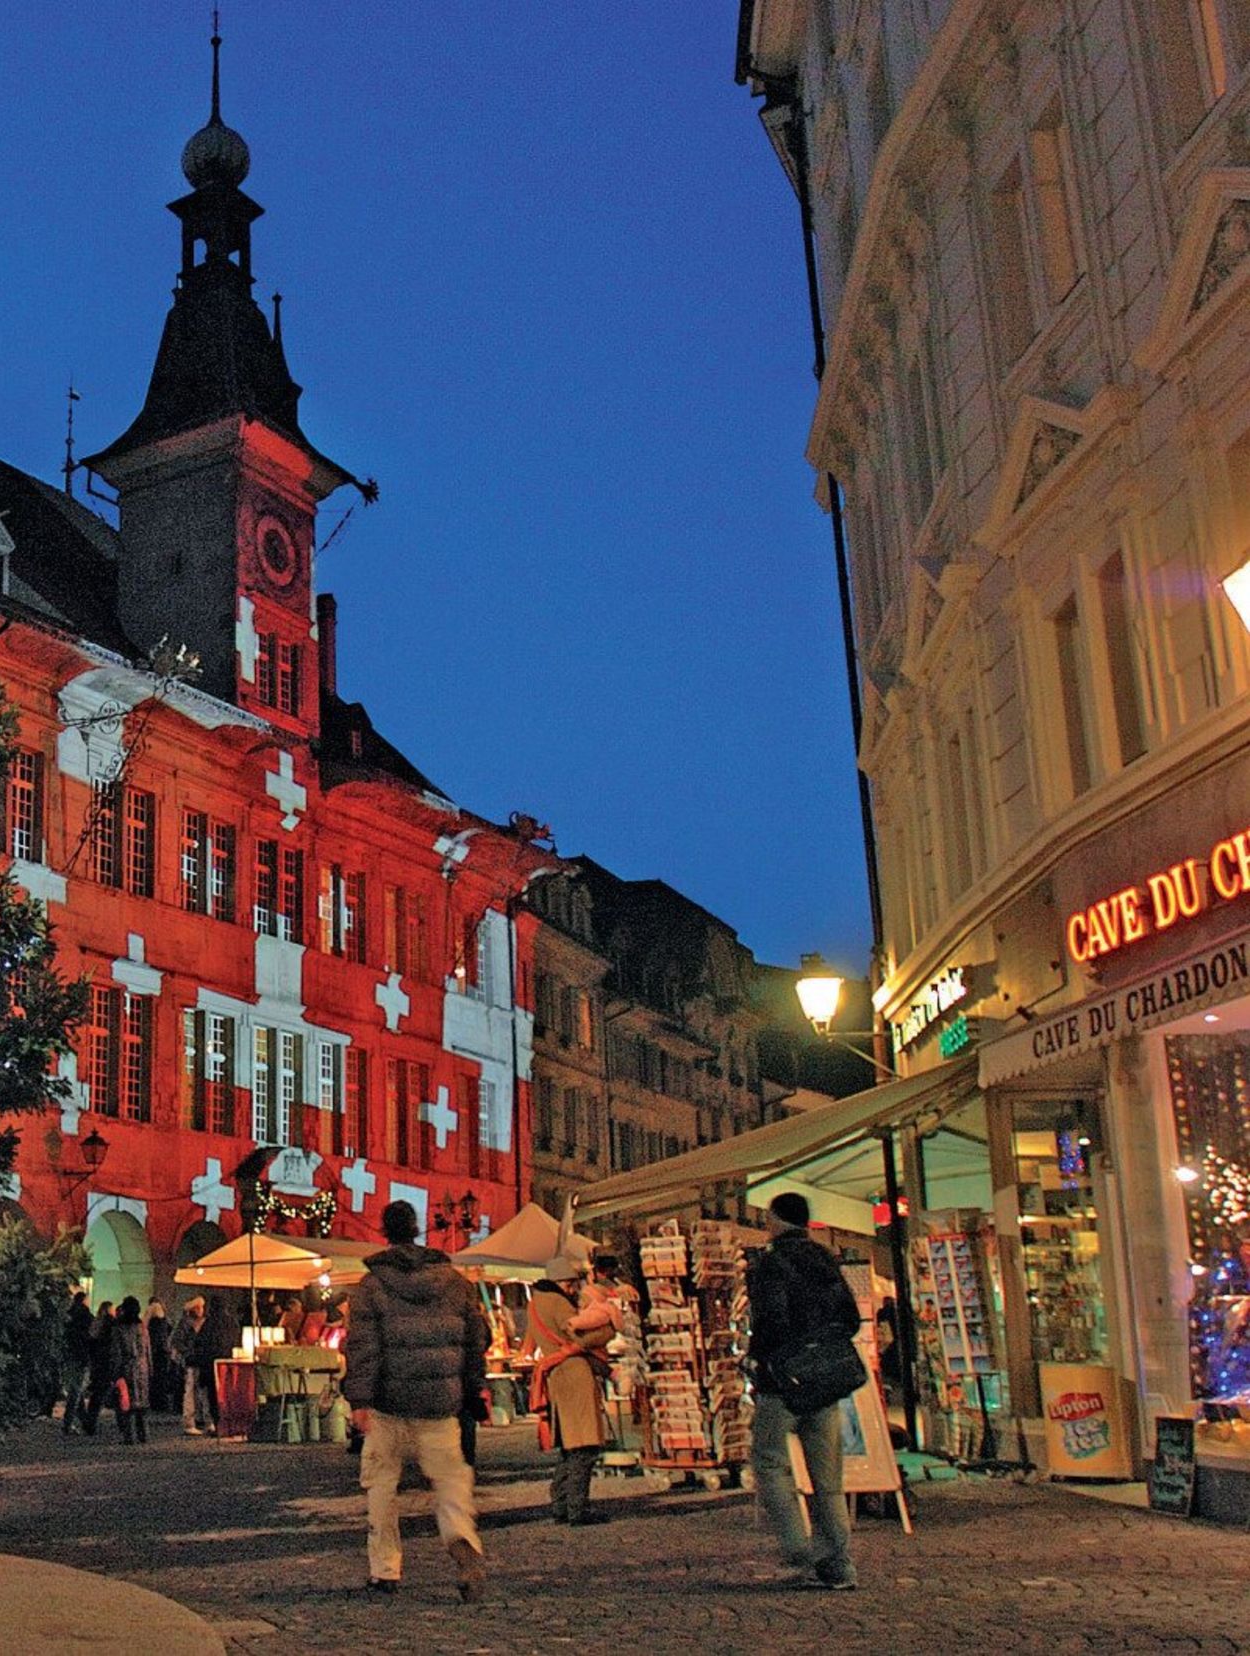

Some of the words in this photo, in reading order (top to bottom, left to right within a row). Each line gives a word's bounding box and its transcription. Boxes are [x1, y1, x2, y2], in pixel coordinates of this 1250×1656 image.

[1067, 888, 1144, 962] CAVE
[1148, 858, 1201, 929] DU
[1032, 1015, 1080, 1059] CAVE
[1089, 1001, 1116, 1037] DU
[1051, 1396, 1101, 1418] Lipton
